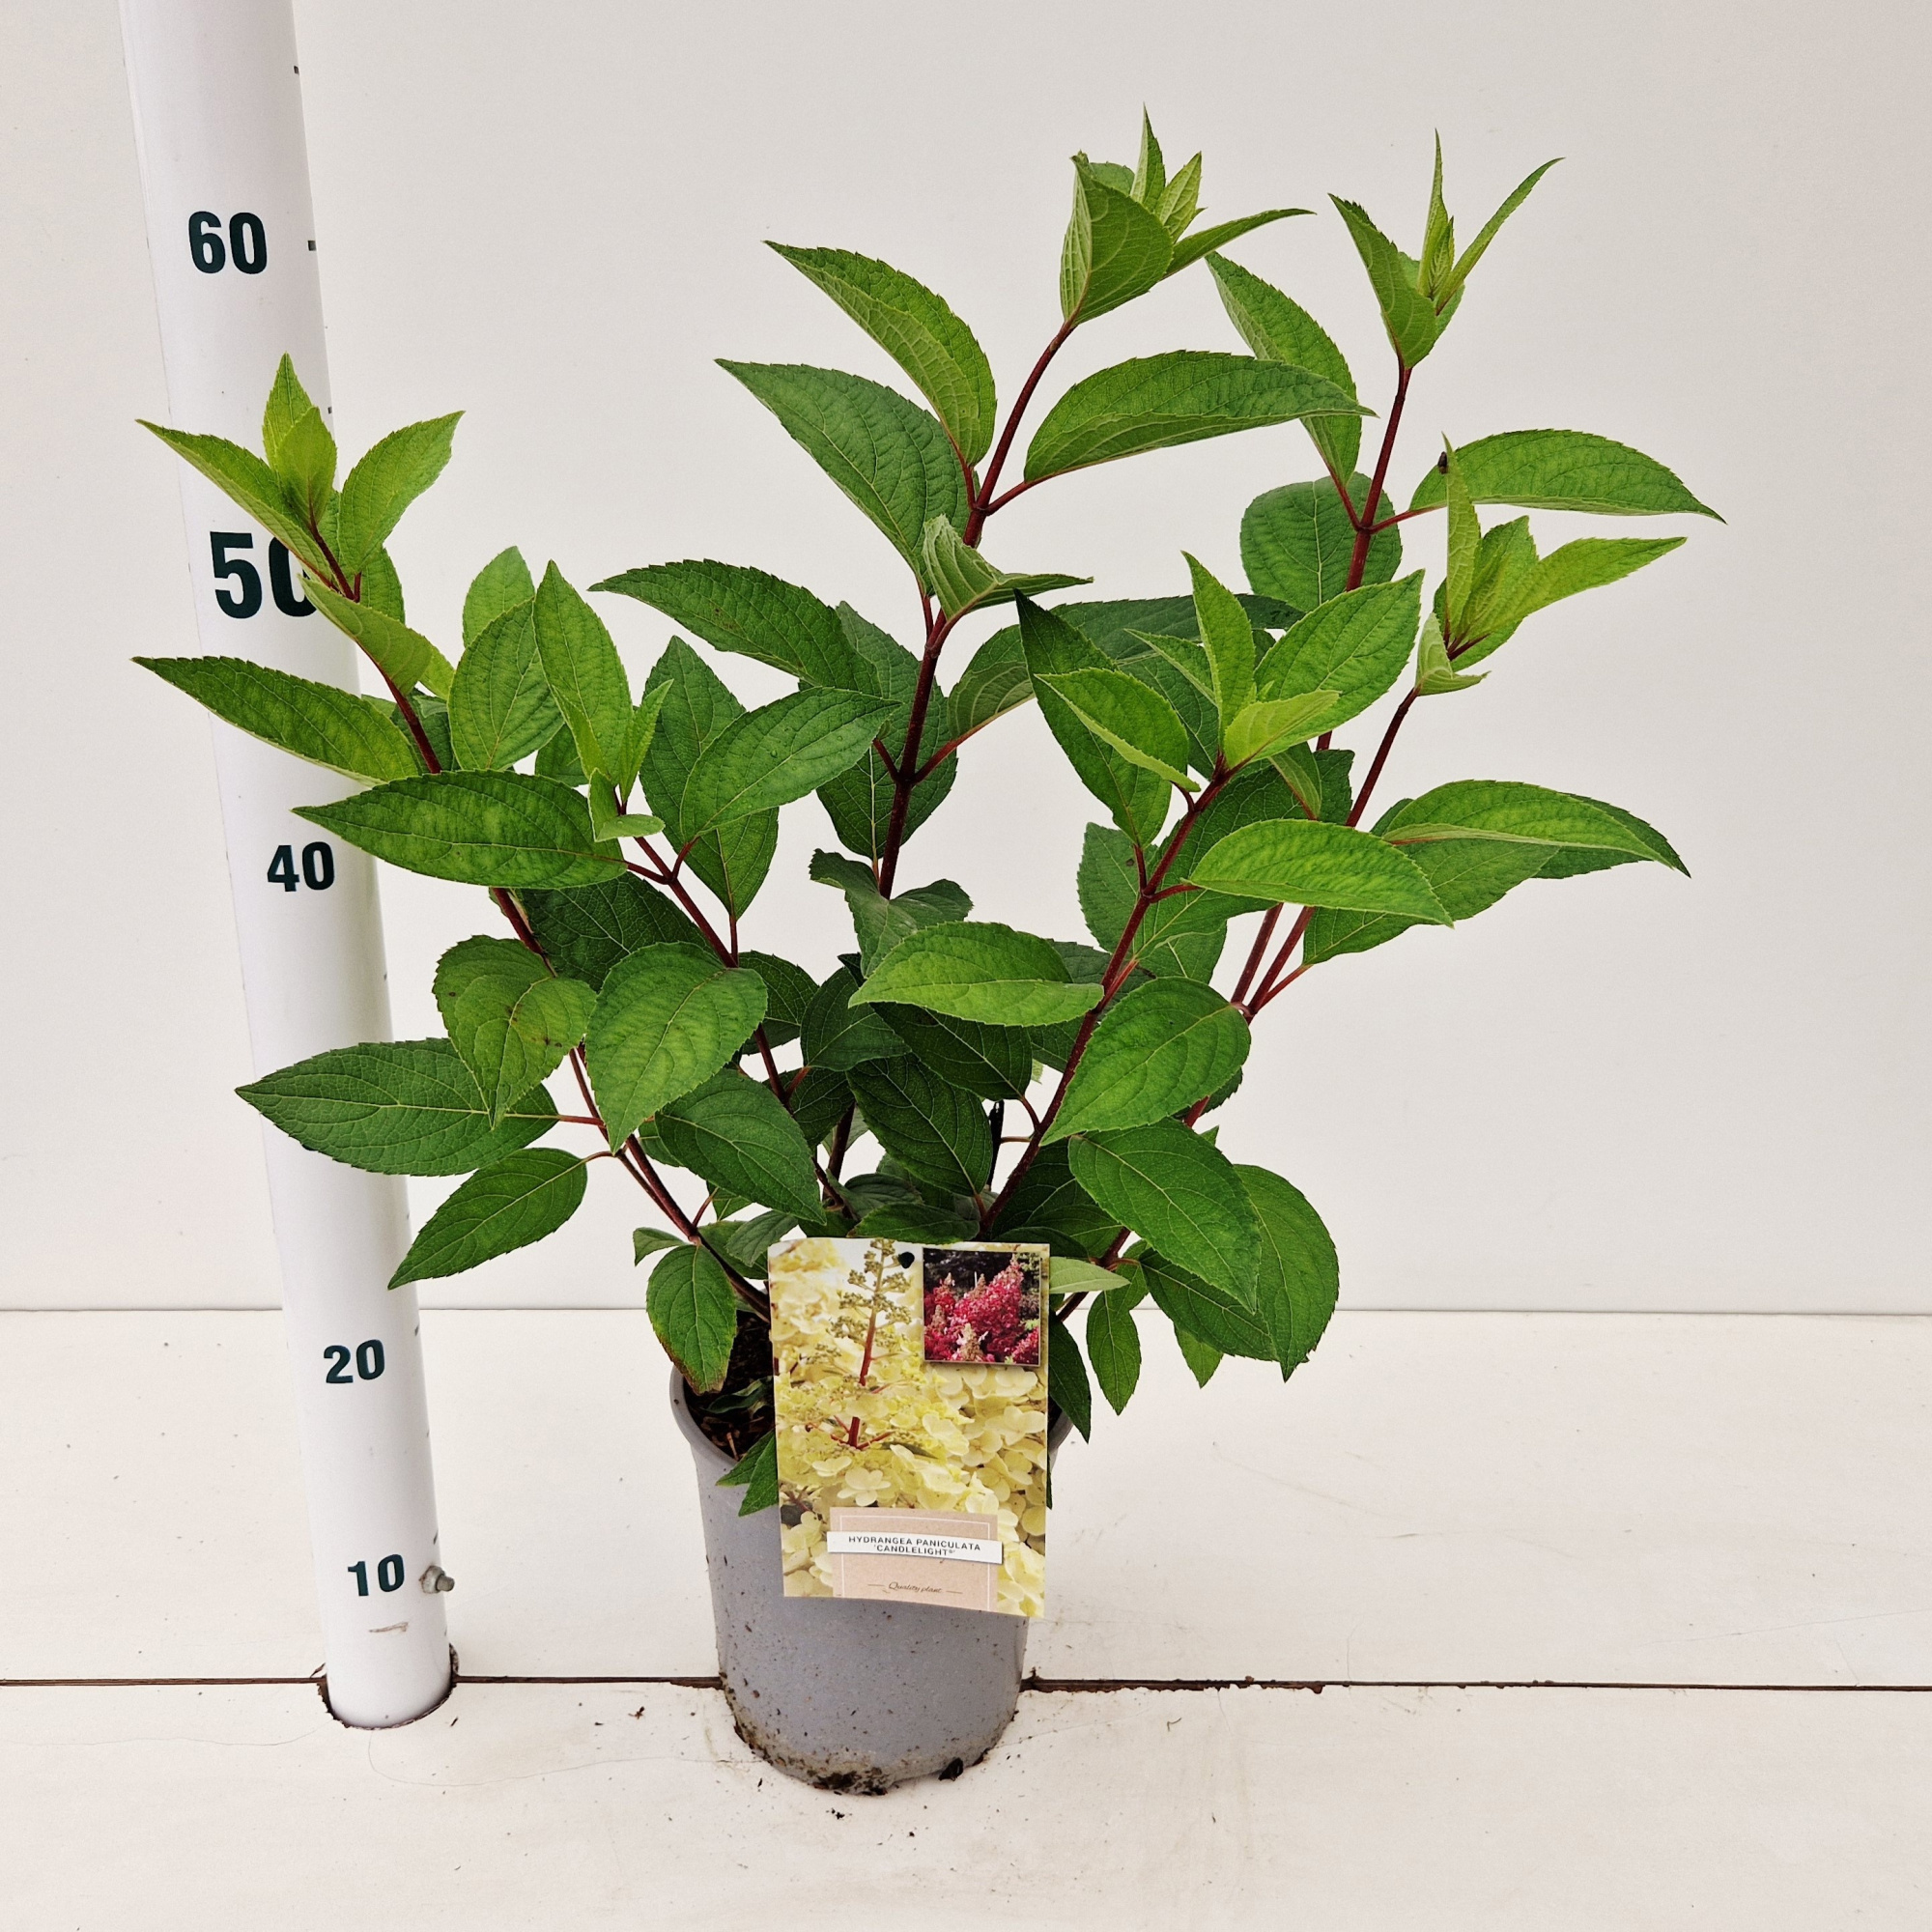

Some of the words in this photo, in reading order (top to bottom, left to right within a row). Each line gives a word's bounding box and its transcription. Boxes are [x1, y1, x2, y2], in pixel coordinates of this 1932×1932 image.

[187, 211, 268, 275] 60
[209, 530, 317, 619] 50
[267, 840, 335, 893] 40
[323, 1339, 385, 1384] 20
[848, 1536, 913, 1546] HYDRANGEA
[916, 1538, 981, 1551] PANICULATA
[347, 1553, 405, 1597] 10
[888, 1581, 921, 1593] Quality
